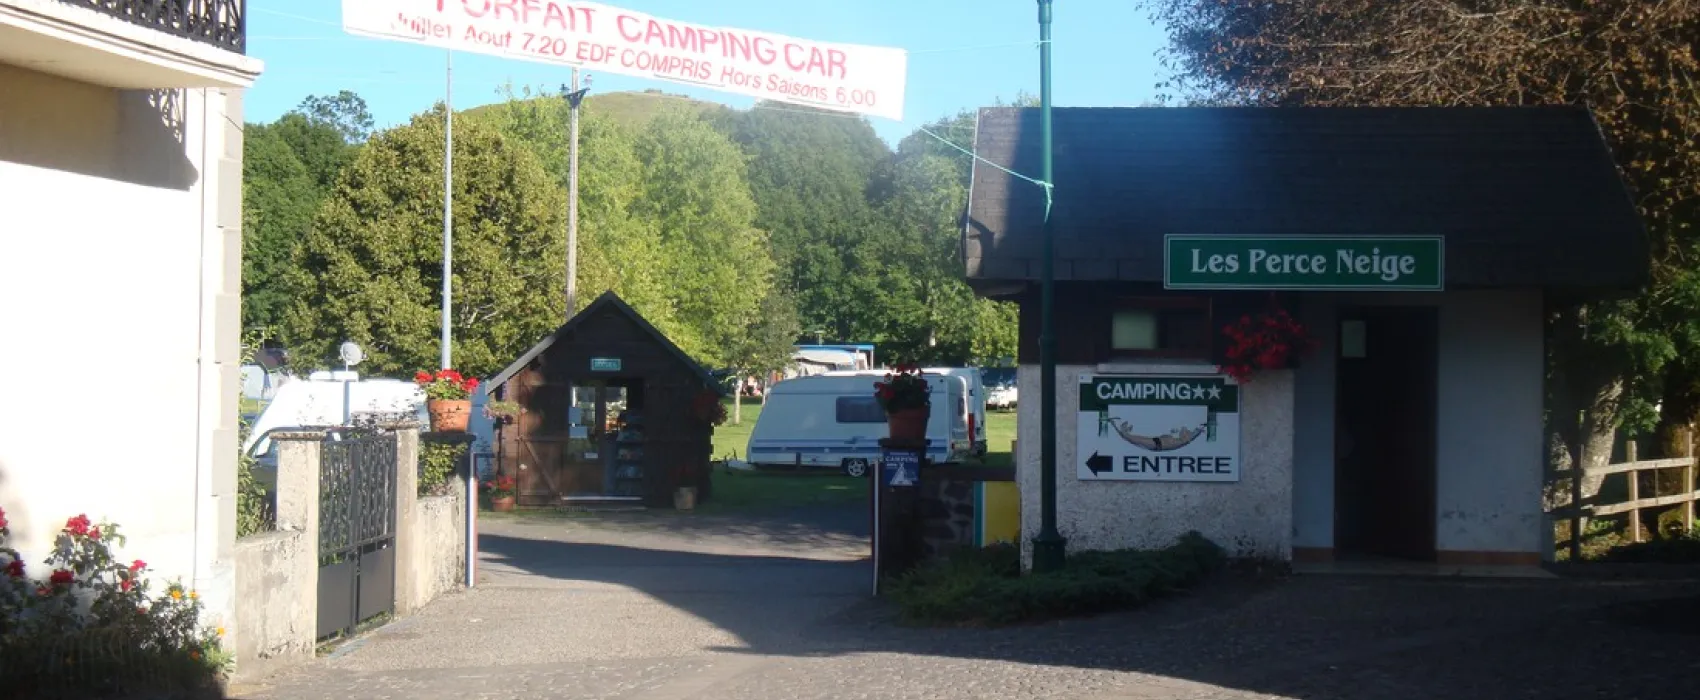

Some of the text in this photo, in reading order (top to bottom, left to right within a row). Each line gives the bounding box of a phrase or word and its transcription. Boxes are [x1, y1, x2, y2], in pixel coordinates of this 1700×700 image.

[616, 14, 777, 65] CAMPING
[784, 43, 847, 80] CAR
[521, 32, 567, 57] 7.20
[575, 41, 617, 64] EDF
[620, 47, 712, 80] COMPRIS
[720, 65, 762, 89] Hors
[766, 73, 828, 101] Saisons
[1191, 247, 1416, 281] Les Perce Neige
[1096, 381, 1191, 400] CAMPING
[1123, 455, 1232, 474] ENTREE
